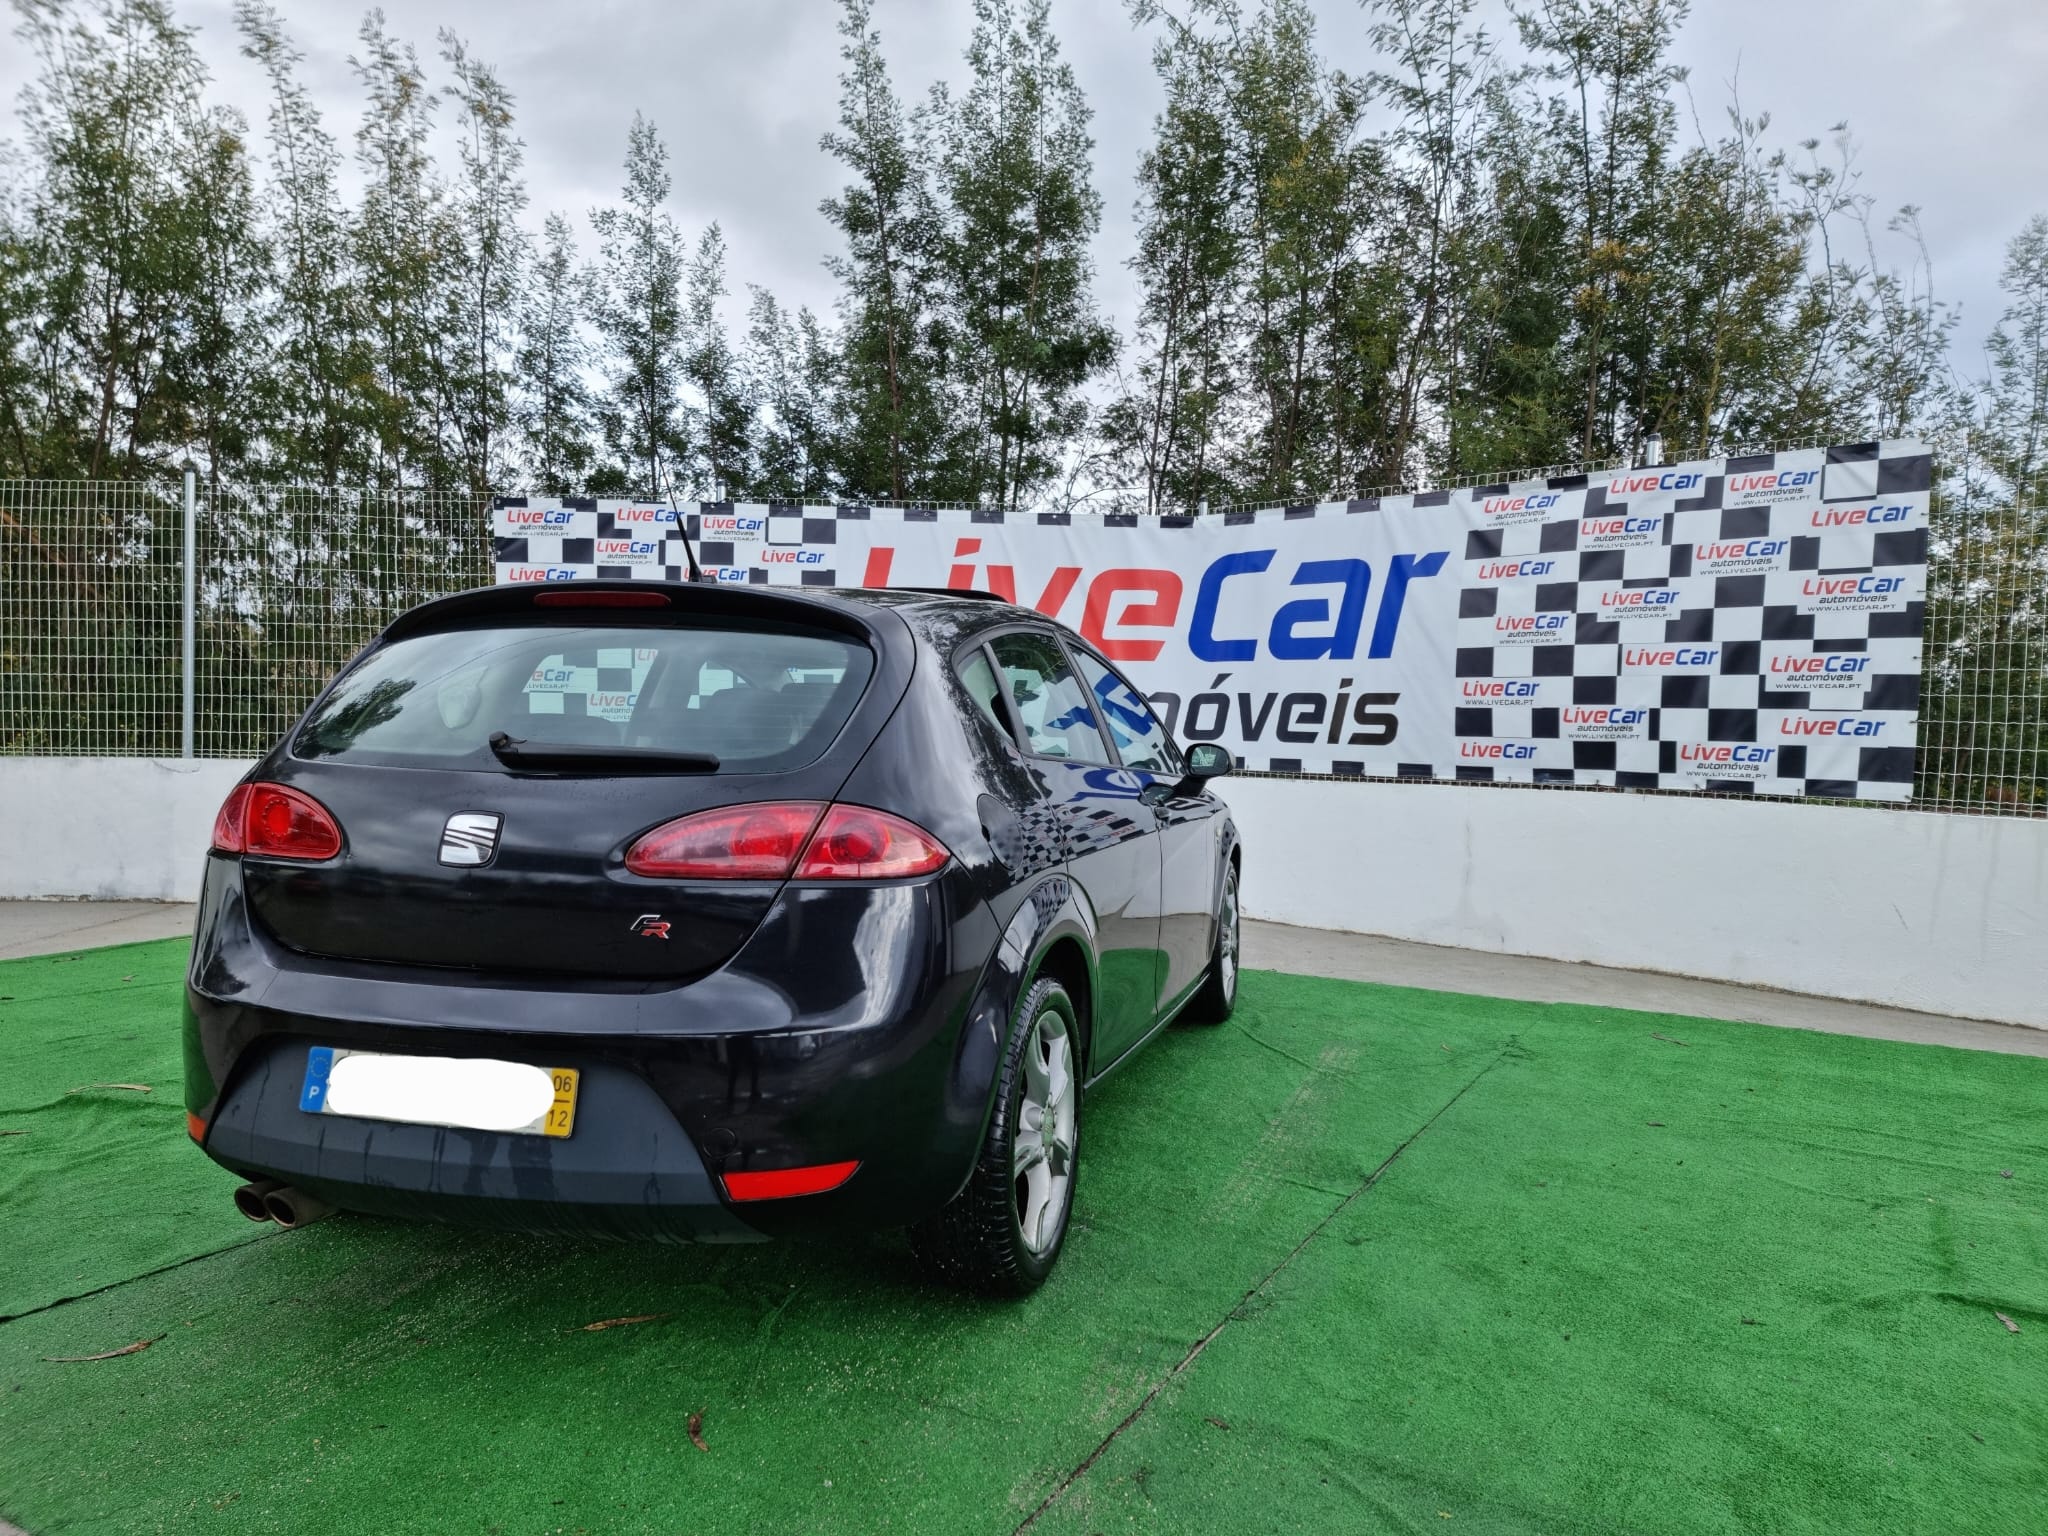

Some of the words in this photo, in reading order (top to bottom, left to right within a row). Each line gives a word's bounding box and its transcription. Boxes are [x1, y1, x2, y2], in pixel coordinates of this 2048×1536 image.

[1610, 473, 1703, 494] LiveCar
[1730, 470, 1819, 492] LiveCar
[1743, 487, 1804, 499] automóveis
[1484, 494, 1561, 513] LiveCar
[507, 509, 574, 524] LiveCar
[1495, 509, 1546, 520] automóveis
[1811, 505, 1914, 527] LiveCar
[704, 516, 764, 530] LiveCar
[1581, 518, 1662, 535] LiveCar
[1593, 533, 1648, 542] automóveis
[596, 540, 657, 553] LiveCar
[1696, 540, 1788, 560] LiveCar
[761, 549, 824, 564] LiveCar
[1710, 557, 1772, 568] automóveis
[509, 567, 576, 581] LiveCar
[684, 567, 747, 581] LeCar
[1478, 560, 1555, 579] LiveCar
[1802, 576, 1905, 596] LiveCar
[1601, 590, 1680, 606] LiveCar
[1818, 593, 1888, 604] automóveis
[1614, 605, 1667, 613] automóveis
[1496, 615, 1569, 630] LiveCar
[1507, 629, 1557, 638] automóveis
[1625, 648, 1718, 666] LiveCar
[1771, 655, 1871, 673] LiveCar
[1786, 673, 1853, 682] automóveis
[1463, 680, 1540, 697] LiveCar
[1563, 706, 1647, 724] LiveCar
[1577, 723, 1634, 732] automóveis
[1781, 717, 1886, 736] LiveCar
[1461, 742, 1538, 759] LiveCar
[1681, 743, 1776, 762] LiveCar
[1697, 762, 1760, 771] automóveis
[553, 1074, 573, 1093] 06
[308, 1085, 320, 1099] P
[549, 1108, 568, 1128] 12
